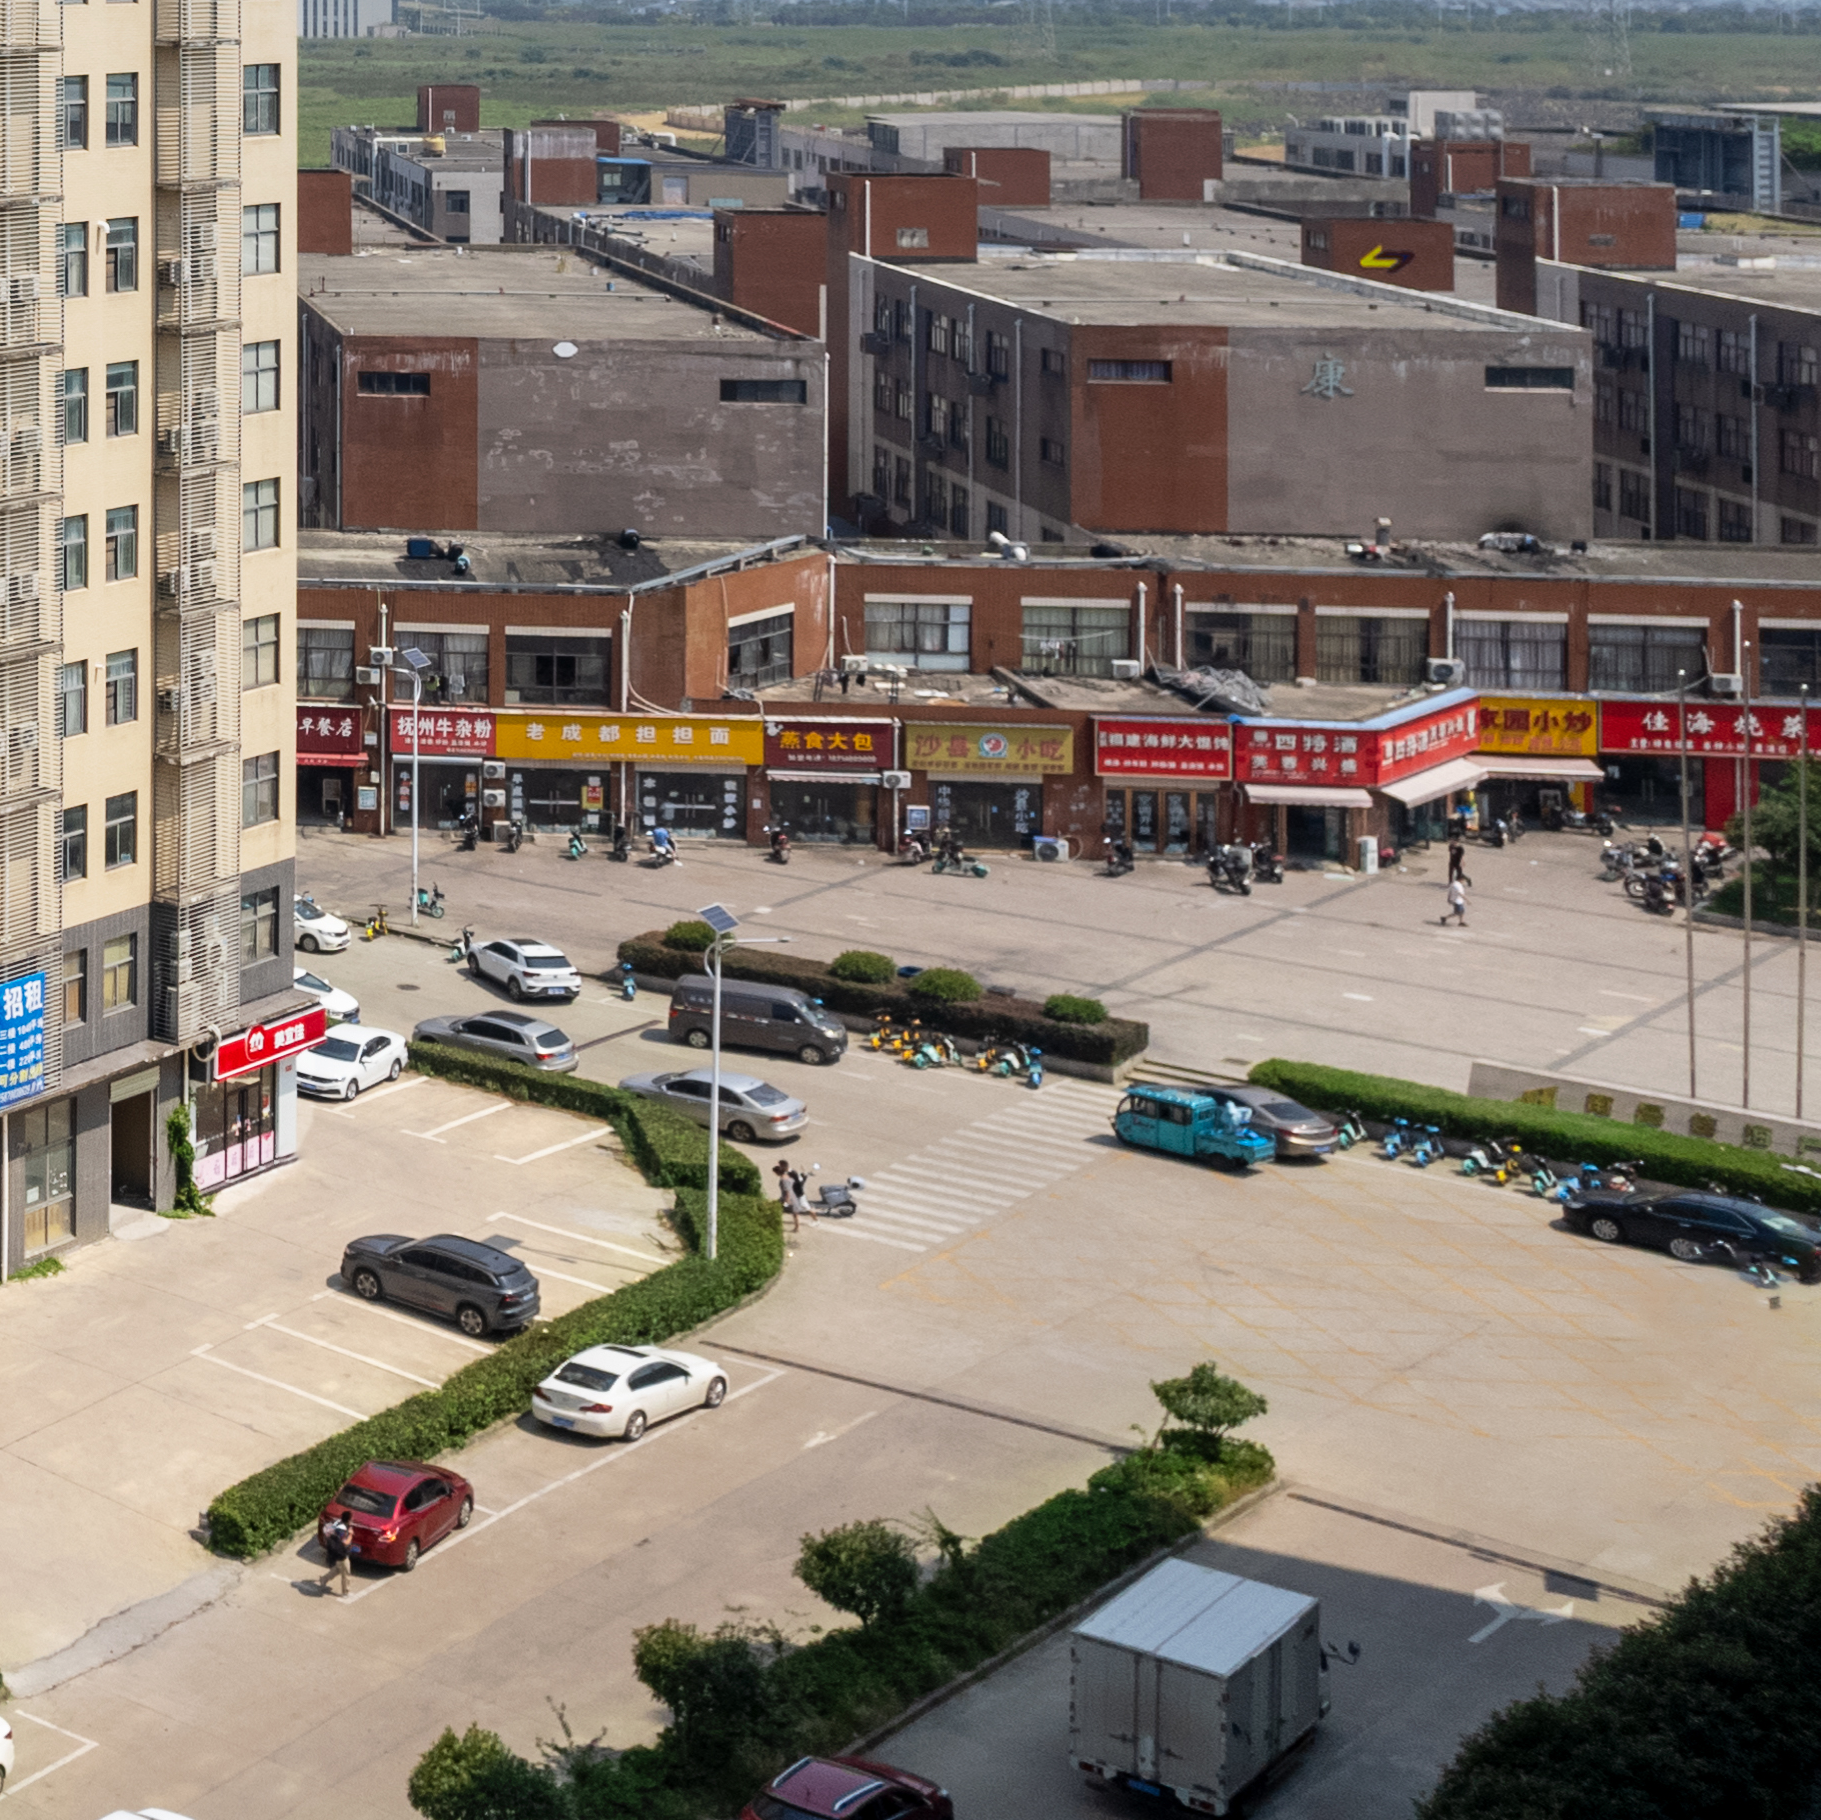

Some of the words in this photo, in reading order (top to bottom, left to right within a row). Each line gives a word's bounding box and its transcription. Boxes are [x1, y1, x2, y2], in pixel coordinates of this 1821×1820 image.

[1301, 351, 1355, 397] 康
[297, 717, 353, 738] 早餐店
[397, 715, 492, 739] 抚州牛杂粉
[526, 721, 731, 746] 老成都担担面
[3, 979, 44, 1021] 招租
[274, 1022, 306, 1050] 美宜佳
